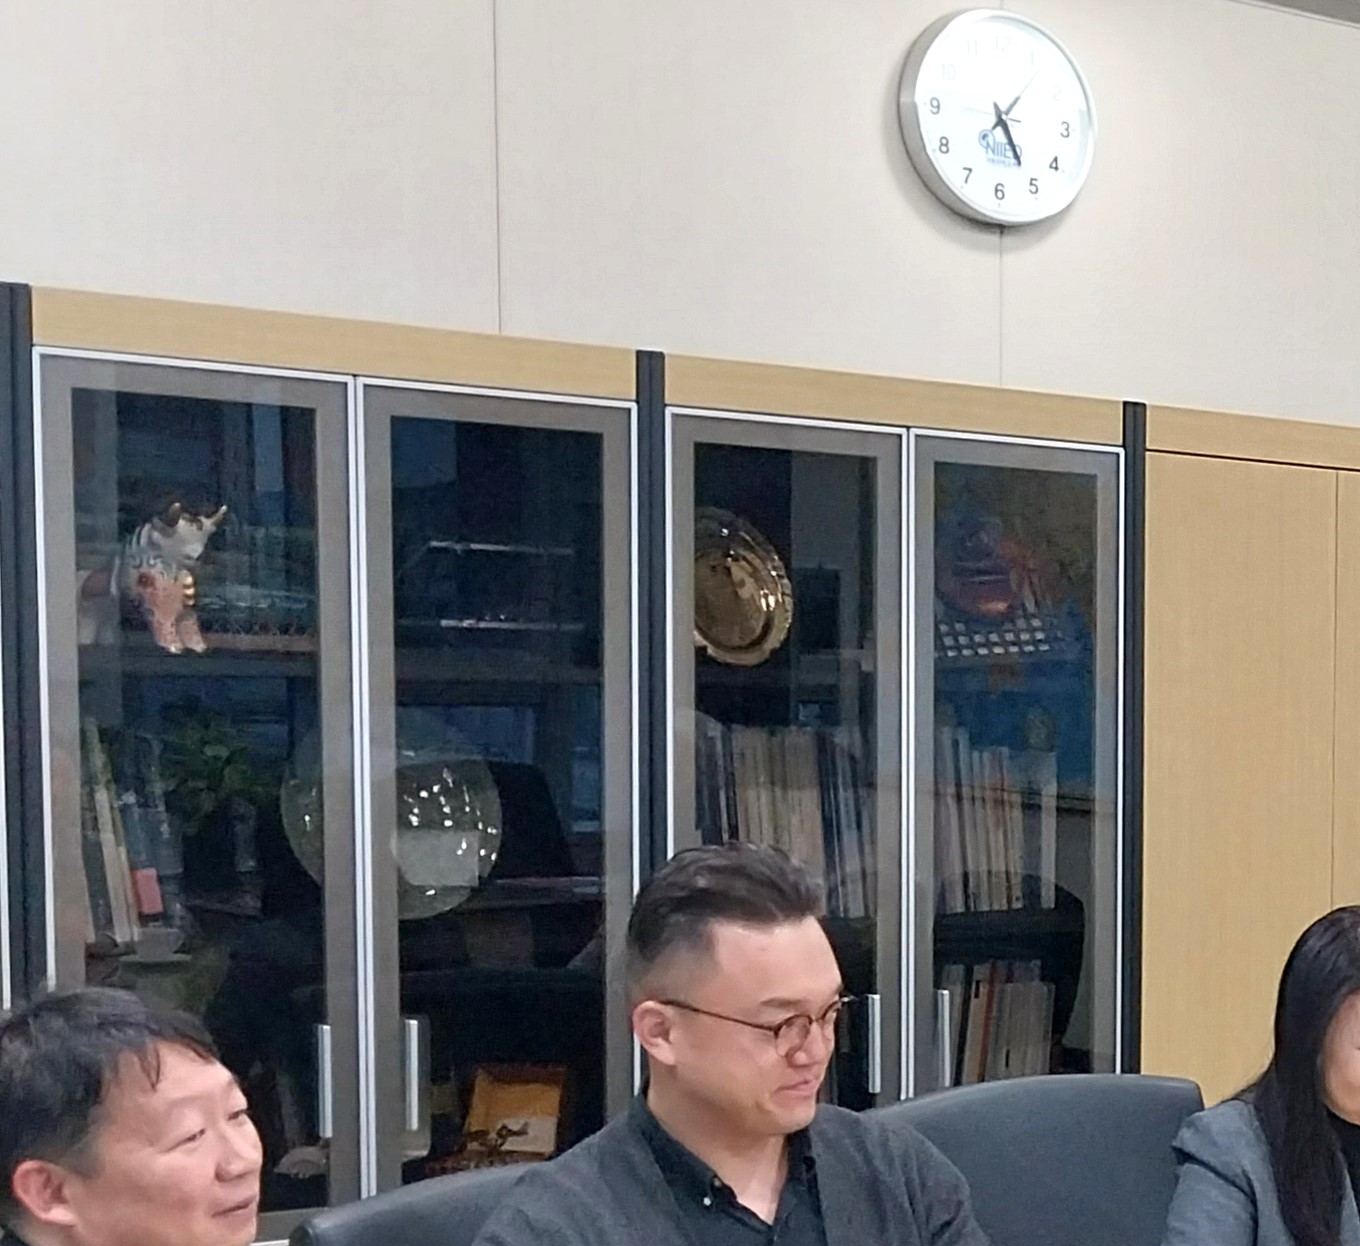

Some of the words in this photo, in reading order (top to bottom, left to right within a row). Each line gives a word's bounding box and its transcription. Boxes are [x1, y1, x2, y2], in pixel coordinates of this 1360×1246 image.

[929, 96, 942, 116] 9
[1060, 120, 1071, 139] 3
[938, 136, 950, 155] 8
[1048, 155, 1060, 172] 4
[961, 166, 973, 185] 7
[993, 182, 1006, 201] 6
[1028, 177, 1040, 195] 5
